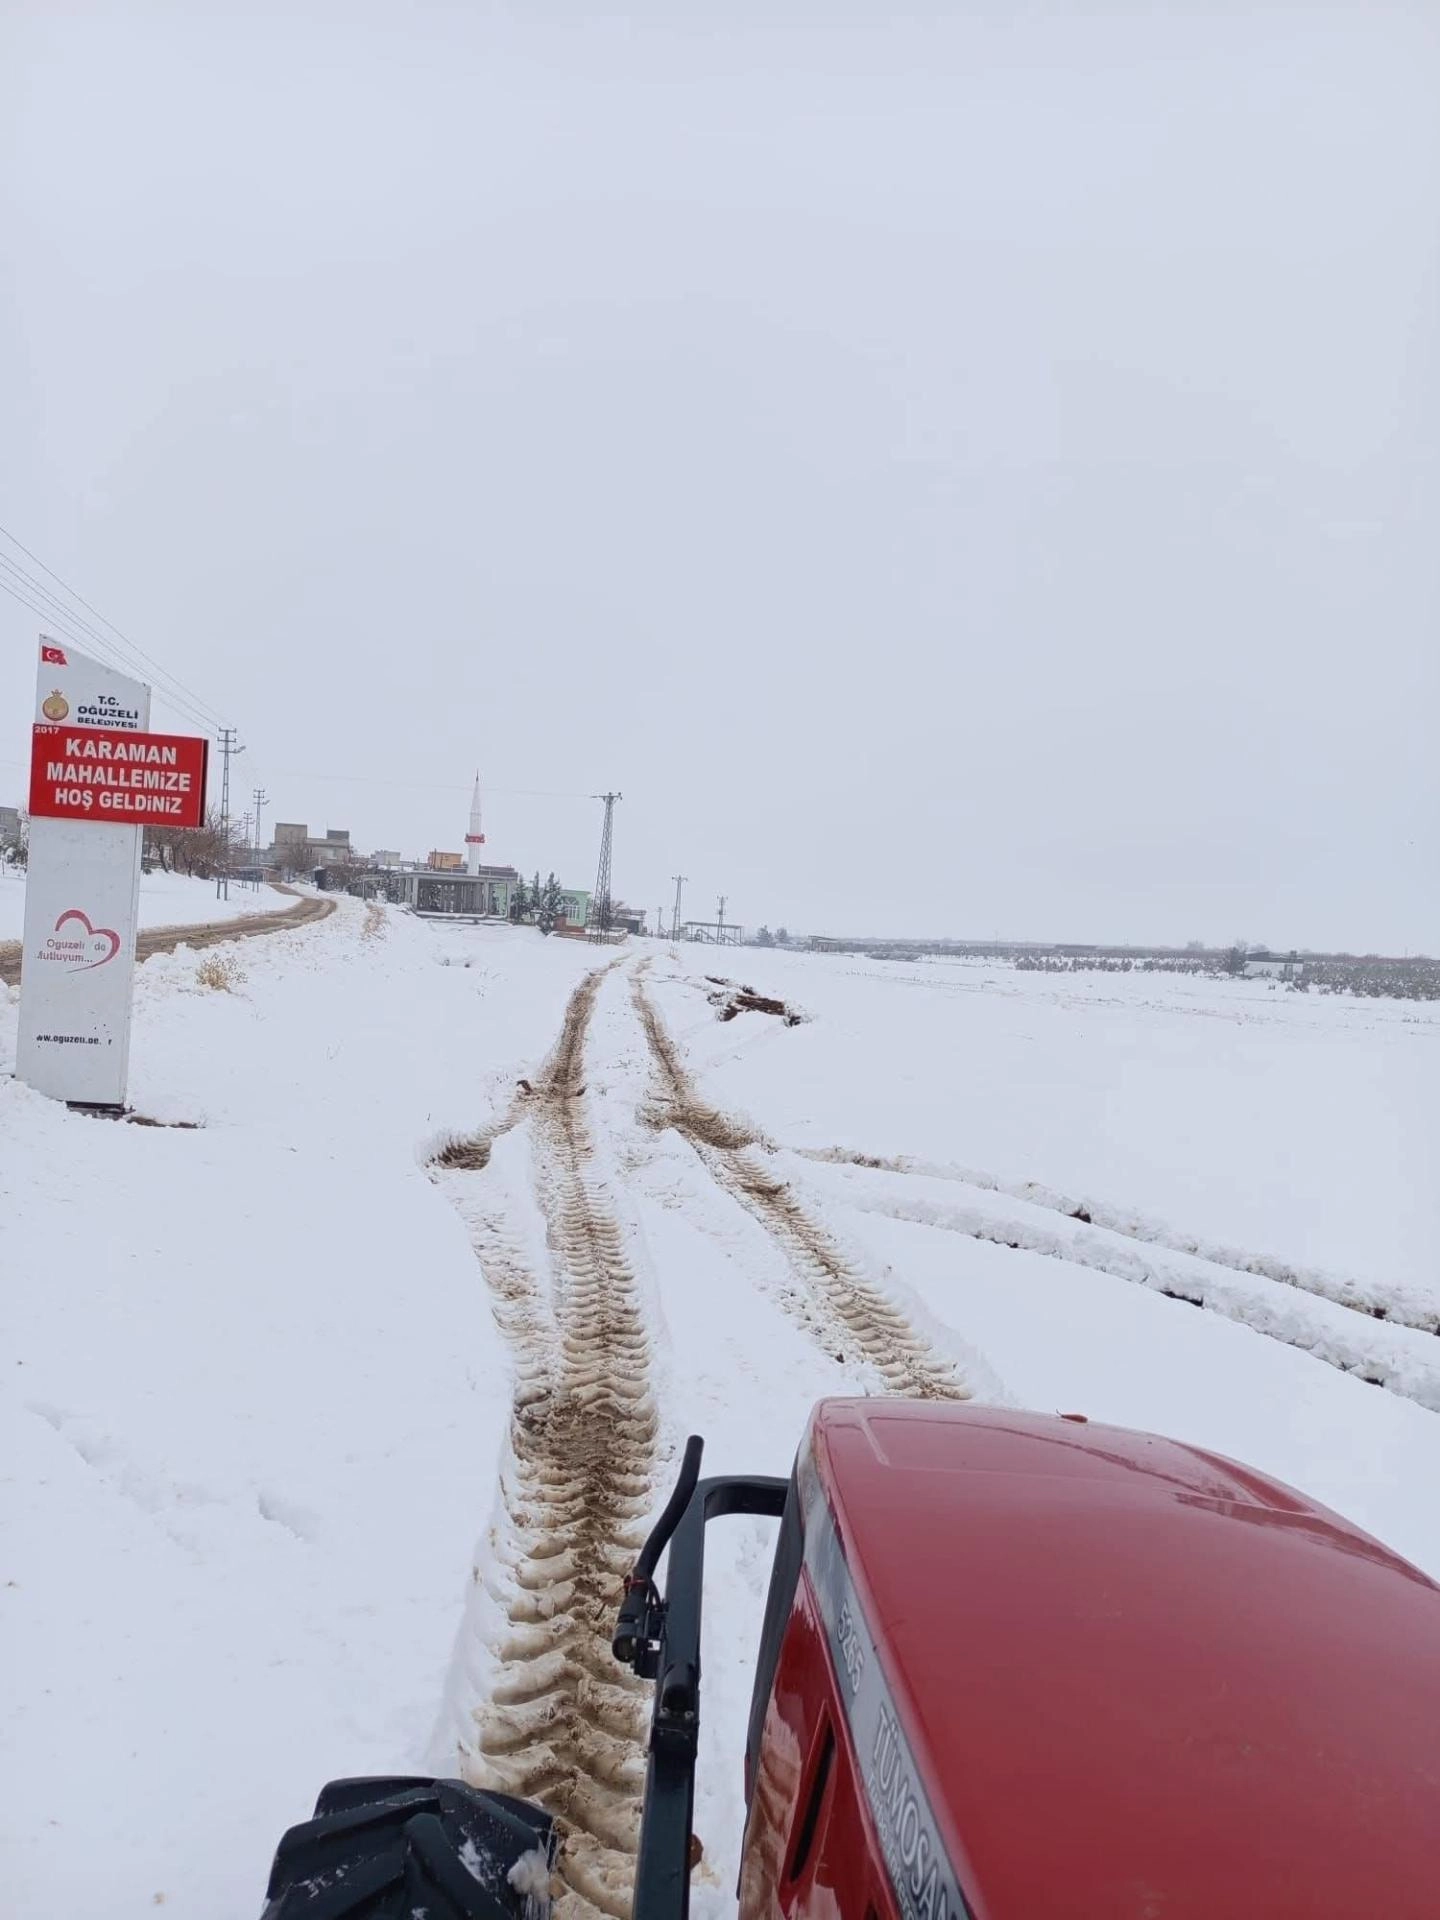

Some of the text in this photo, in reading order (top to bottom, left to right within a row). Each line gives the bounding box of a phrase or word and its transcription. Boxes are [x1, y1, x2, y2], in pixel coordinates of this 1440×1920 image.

[98, 696, 119, 706] T.C.
[78, 705, 138, 719] OĞUZELİ
[34, 726, 60, 734] 2017
[66, 738, 177, 765] KARAMAN
[55, 788, 93, 811] HOŞ
[837, 1601, 864, 1694] 5265
